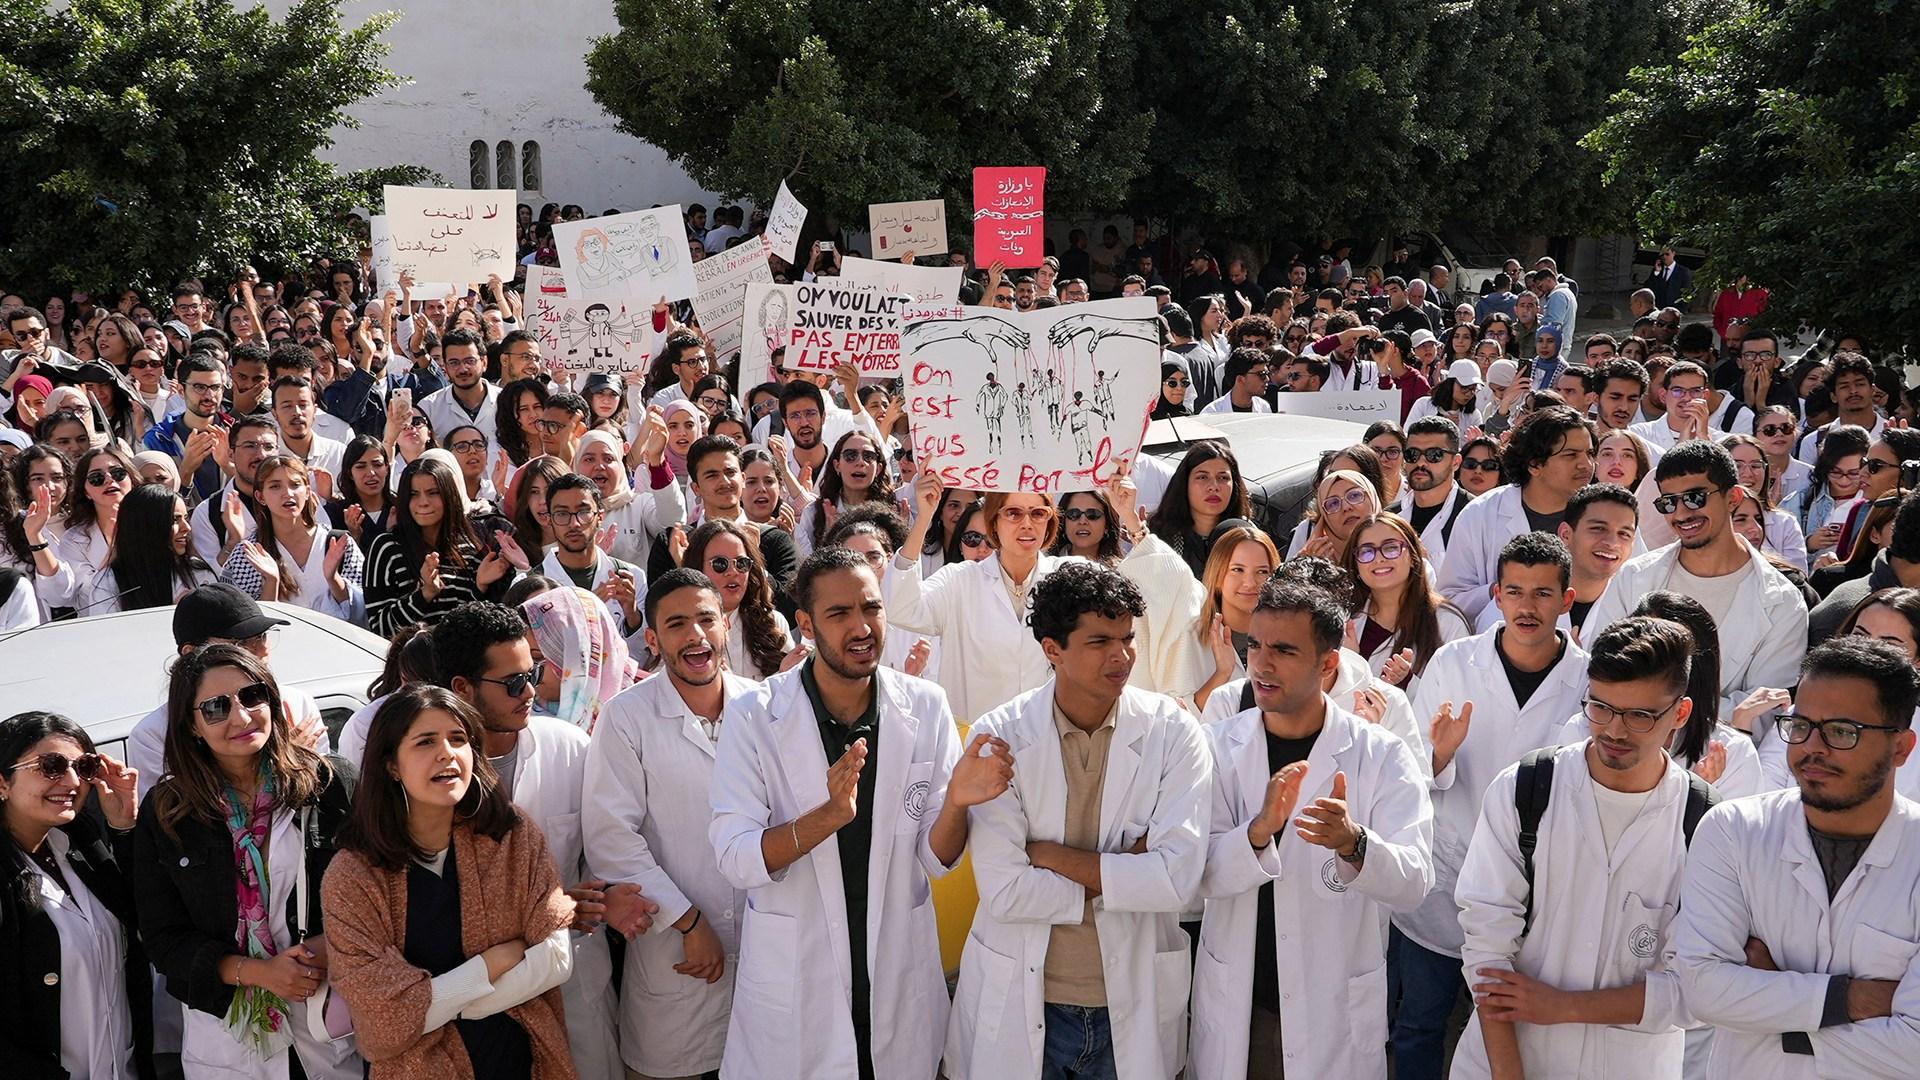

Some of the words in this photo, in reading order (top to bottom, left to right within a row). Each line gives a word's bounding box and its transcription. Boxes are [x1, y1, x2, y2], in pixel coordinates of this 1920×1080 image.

[482, 203, 498, 219] لا
[430, 224, 463, 239] على
[794, 310, 852, 330] SAUVER
[858, 317, 883, 331] DES
[791, 329, 833, 348] PAS
[844, 333, 900, 352] ENTERR
[798, 350, 841, 369] LES
[912, 361, 953, 385] On
[911, 394, 960, 417] est
[910, 423, 965, 456] tous
